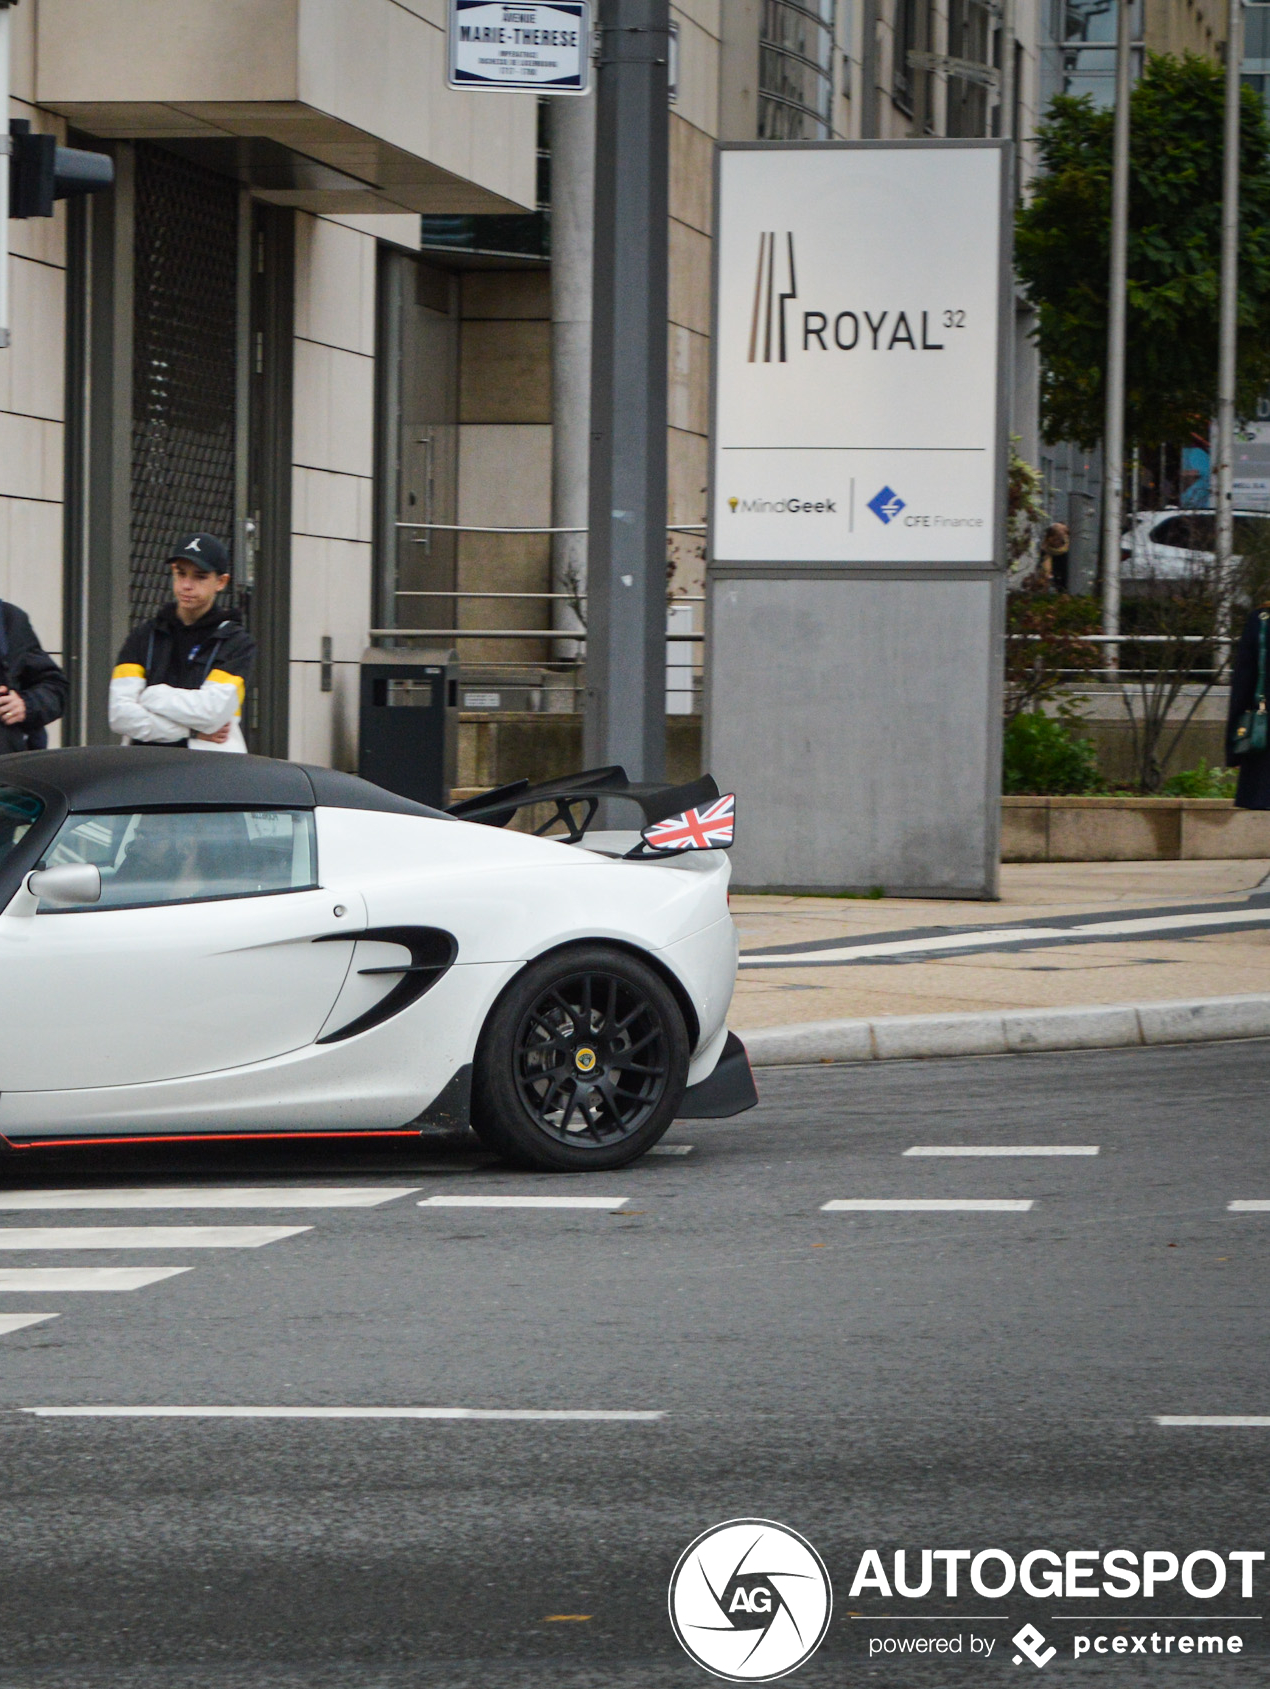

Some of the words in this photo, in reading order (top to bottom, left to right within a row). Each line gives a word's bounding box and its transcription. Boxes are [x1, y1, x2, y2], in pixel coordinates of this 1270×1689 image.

[502, 13, 536, 24] AVENUE
[460, 26, 578, 47] MARIE-THERESE
[803, 311, 944, 350] ROYAL
[942, 310, 965, 328] 32
[740, 498, 836, 513] MindGeek
[904, 516, 931, 527] CFE
[933, 515, 984, 527] Finance
